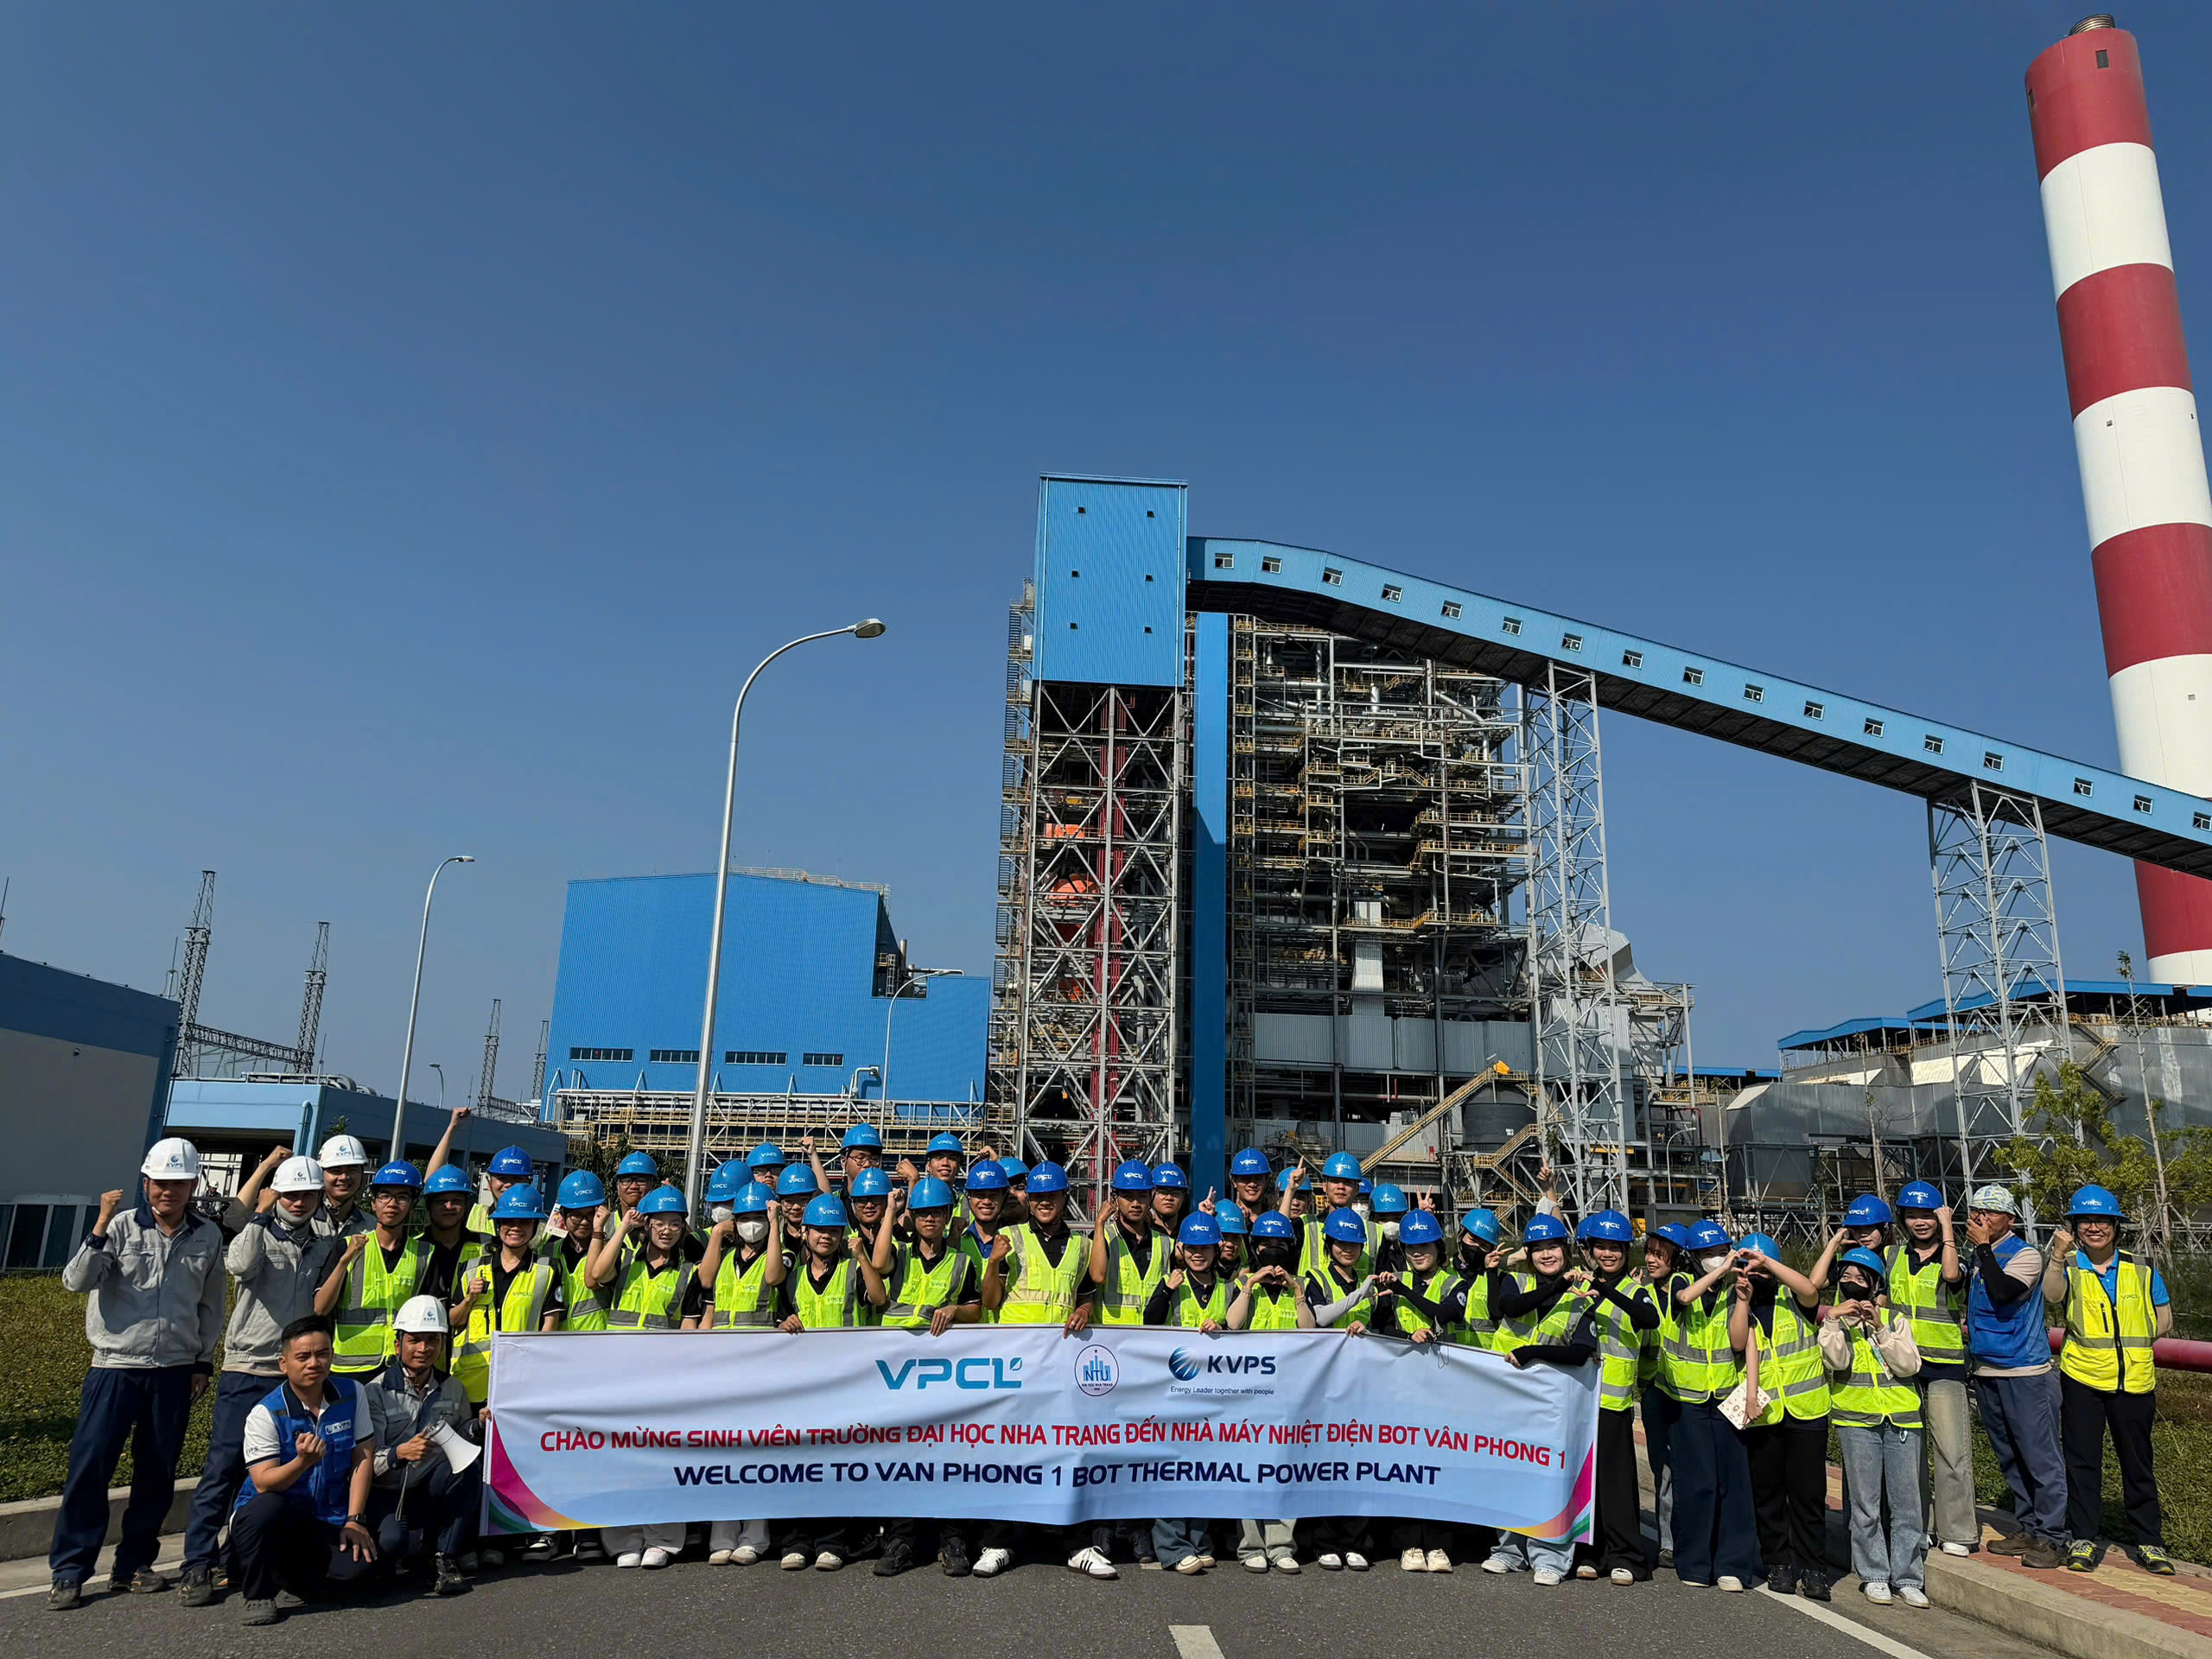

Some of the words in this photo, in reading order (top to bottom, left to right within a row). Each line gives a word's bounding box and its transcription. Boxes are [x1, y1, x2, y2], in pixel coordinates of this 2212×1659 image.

[874, 1357, 1022, 1389] VPCL
[1207, 1355, 1276, 1375] KVPS
[1085, 1370, 1109, 1381] NTU
[1215, 1387, 1239, 1395] together
[334, 1421, 352, 1430] KVPS
[540, 1427, 605, 1452] CHÀO
[611, 1426, 681, 1449] MỪNG
[687, 1430, 742, 1448] SINH
[747, 1424, 801, 1447] VIÊN
[806, 1423, 900, 1446] TRƯỜNG
[906, 1424, 944, 1447] ĐẠI
[950, 1423, 995, 1448] HỌC
[1001, 1424, 1047, 1445] NHA
[1052, 1424, 1120, 1446] TRANG
[1125, 1415, 1166, 1443] ĐẾN
[1171, 1417, 1214, 1443] NHÀ
[1218, 1418, 1265, 1444] MÁY
[1268, 1419, 1324, 1448] NHIỆT
[1326, 1418, 1373, 1447] ĐIỆN
[1378, 1424, 1421, 1445] BOT
[1424, 1426, 1468, 1452] VÂN
[1474, 1434, 1550, 1466] PHONG
[1558, 1450, 1566, 1469] 1
[673, 1463, 823, 1486] WELCOME
[830, 1462, 868, 1482] TO
[874, 1462, 934, 1482] VAN
[943, 1463, 1043, 1485] PHONG
[1051, 1465, 1061, 1486] 1
[1072, 1464, 1123, 1487] BOT
[1128, 1461, 1250, 1483] THERMAL
[1257, 1461, 1349, 1484] POWER
[1356, 1462, 1440, 1485] PLANT
